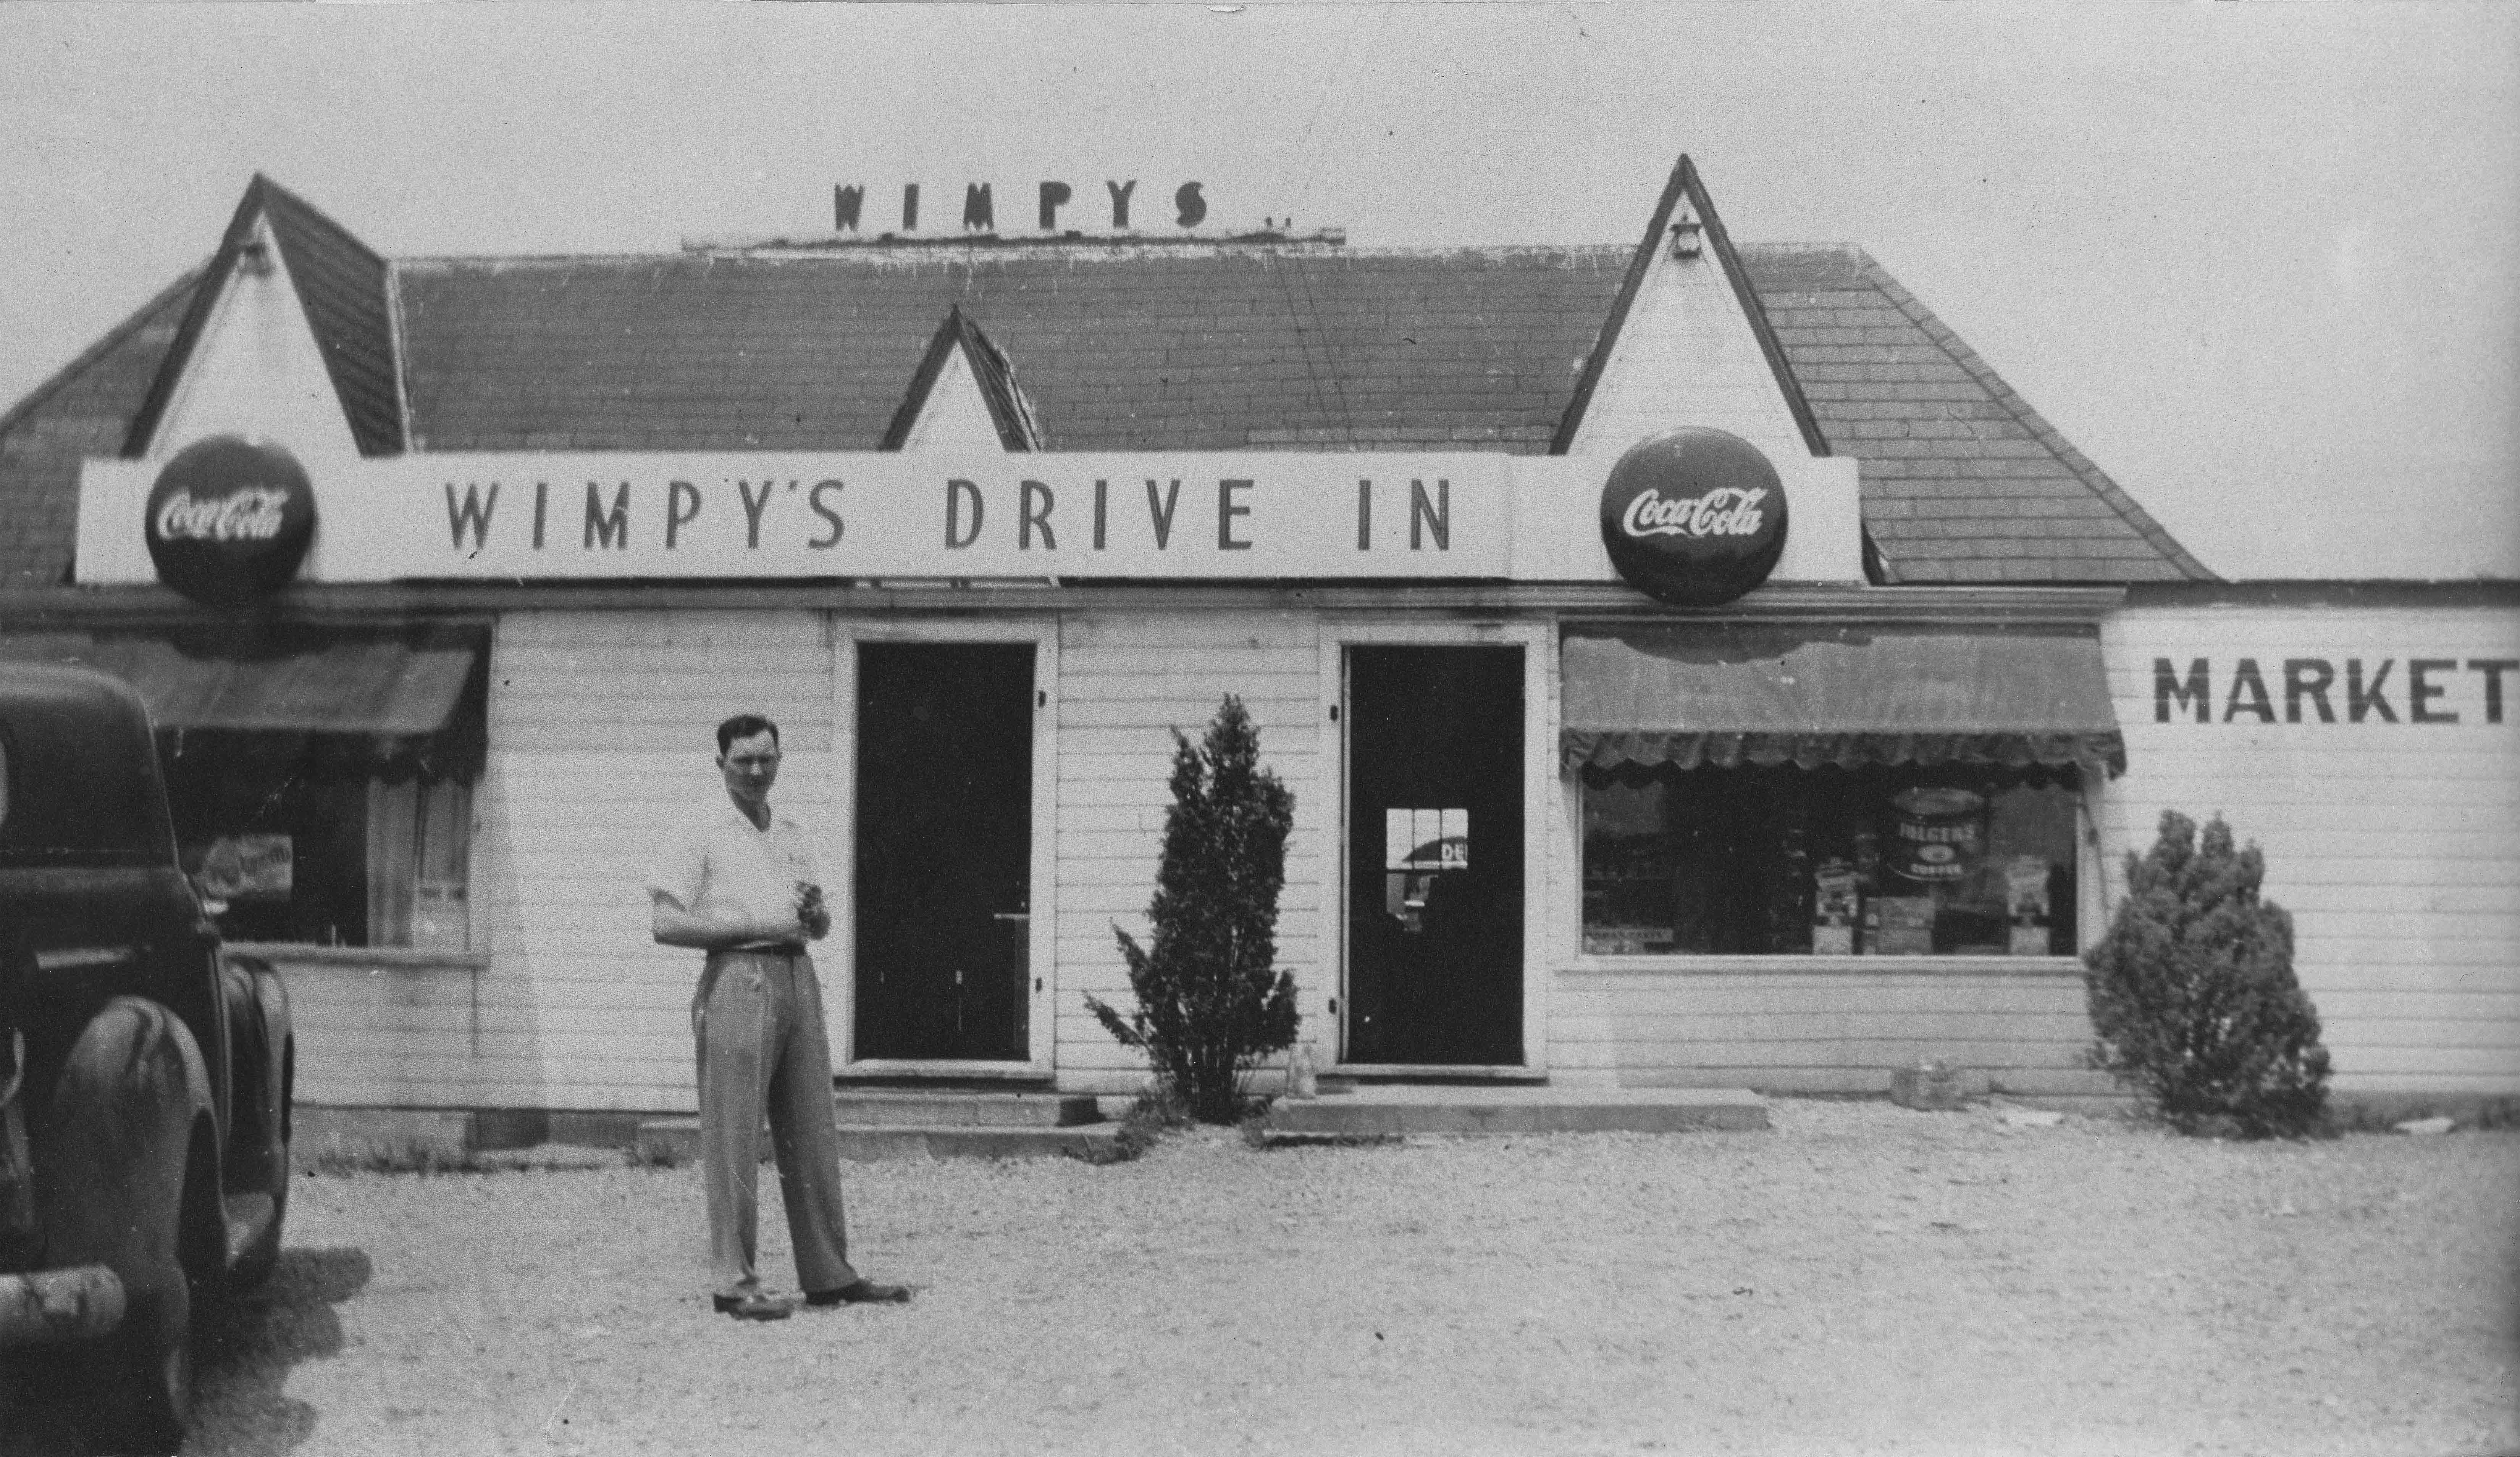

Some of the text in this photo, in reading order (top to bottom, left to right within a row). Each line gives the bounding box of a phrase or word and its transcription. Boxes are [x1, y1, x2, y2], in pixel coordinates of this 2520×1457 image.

[834, 180, 1207, 231] WIMPYS
[445, 478, 1450, 552] WIMPY'S DRIVE IN
[2153, 657, 2520, 724] MARKET
